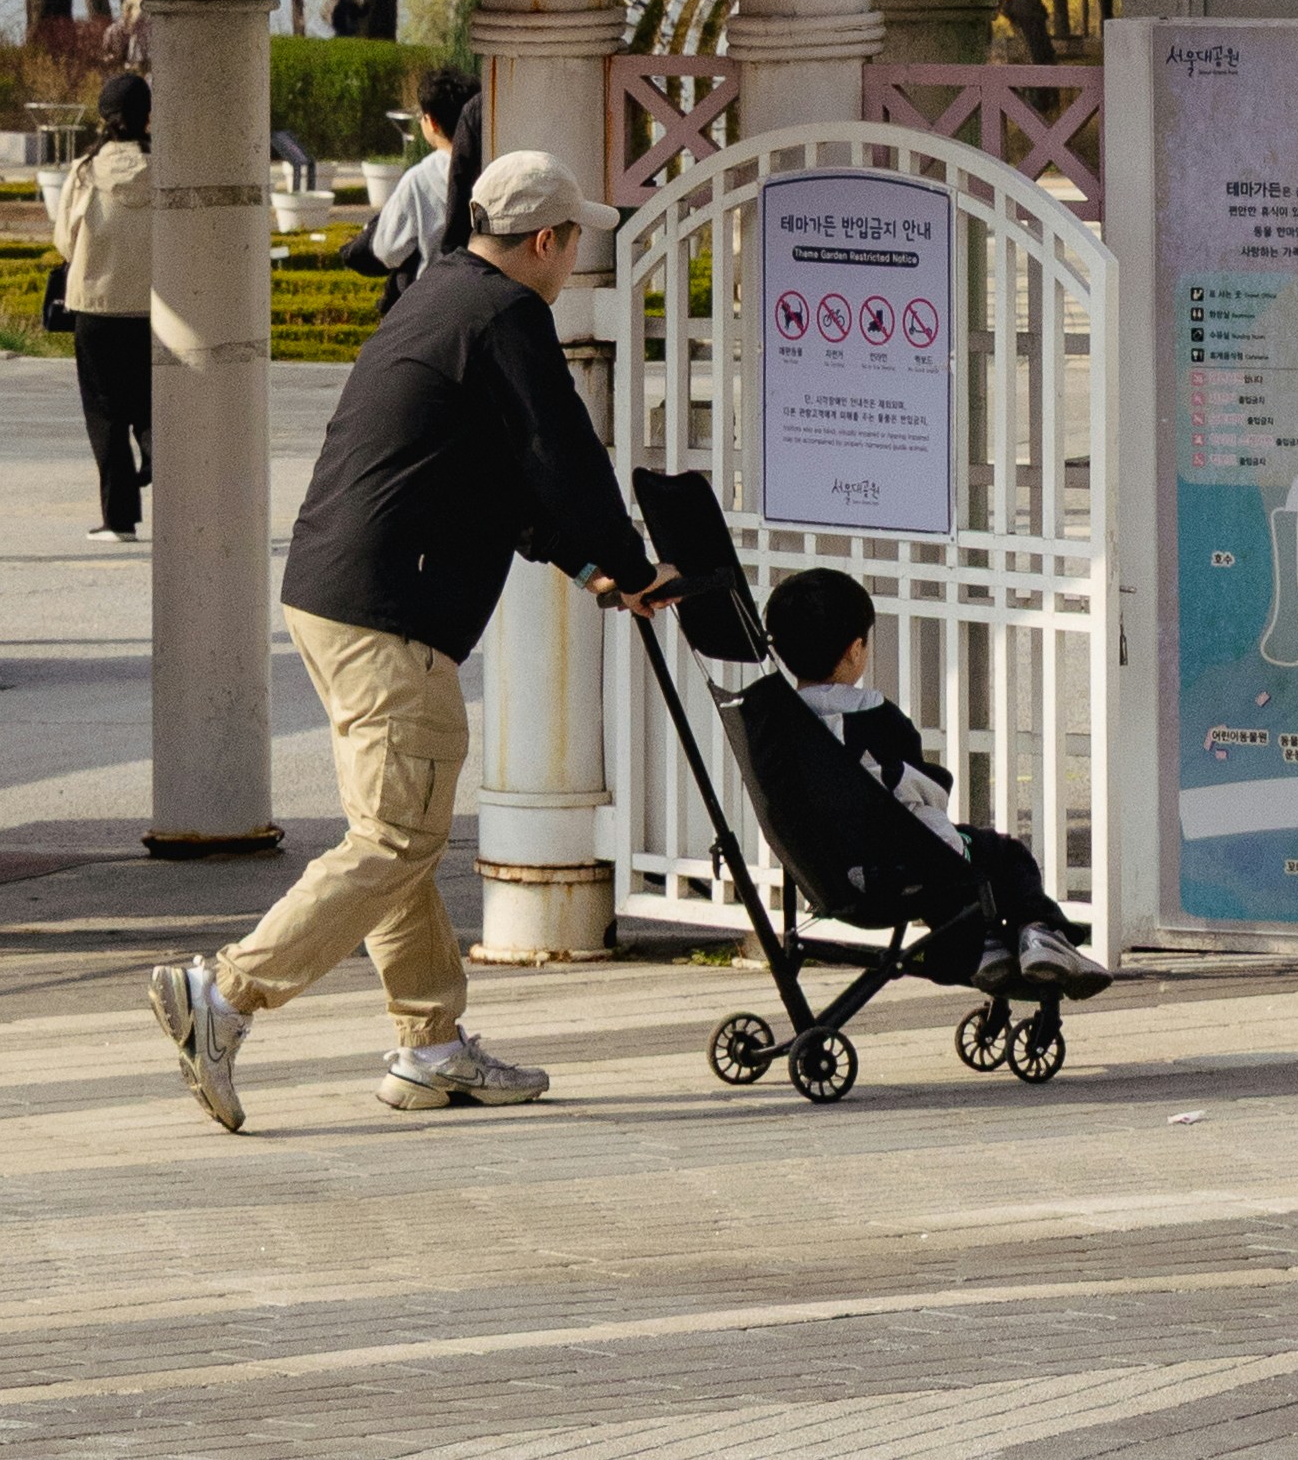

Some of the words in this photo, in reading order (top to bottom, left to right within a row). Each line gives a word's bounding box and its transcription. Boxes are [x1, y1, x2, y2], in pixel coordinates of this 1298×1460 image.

[1226, 181, 1291, 198] 테마가든은
[780, 214, 837, 238] 테마가든
[841, 216, 897, 240] 반입금지
[902, 219, 932, 242] 안내
[794, 248, 818, 259] Theme
[820, 249, 848, 260] Garden
[849, 251, 891, 263] Restricted
[892, 253, 917, 264] Notice
[1213, 553, 1233, 566] 호수
[1211, 730, 1268, 744] 어린이동물원
